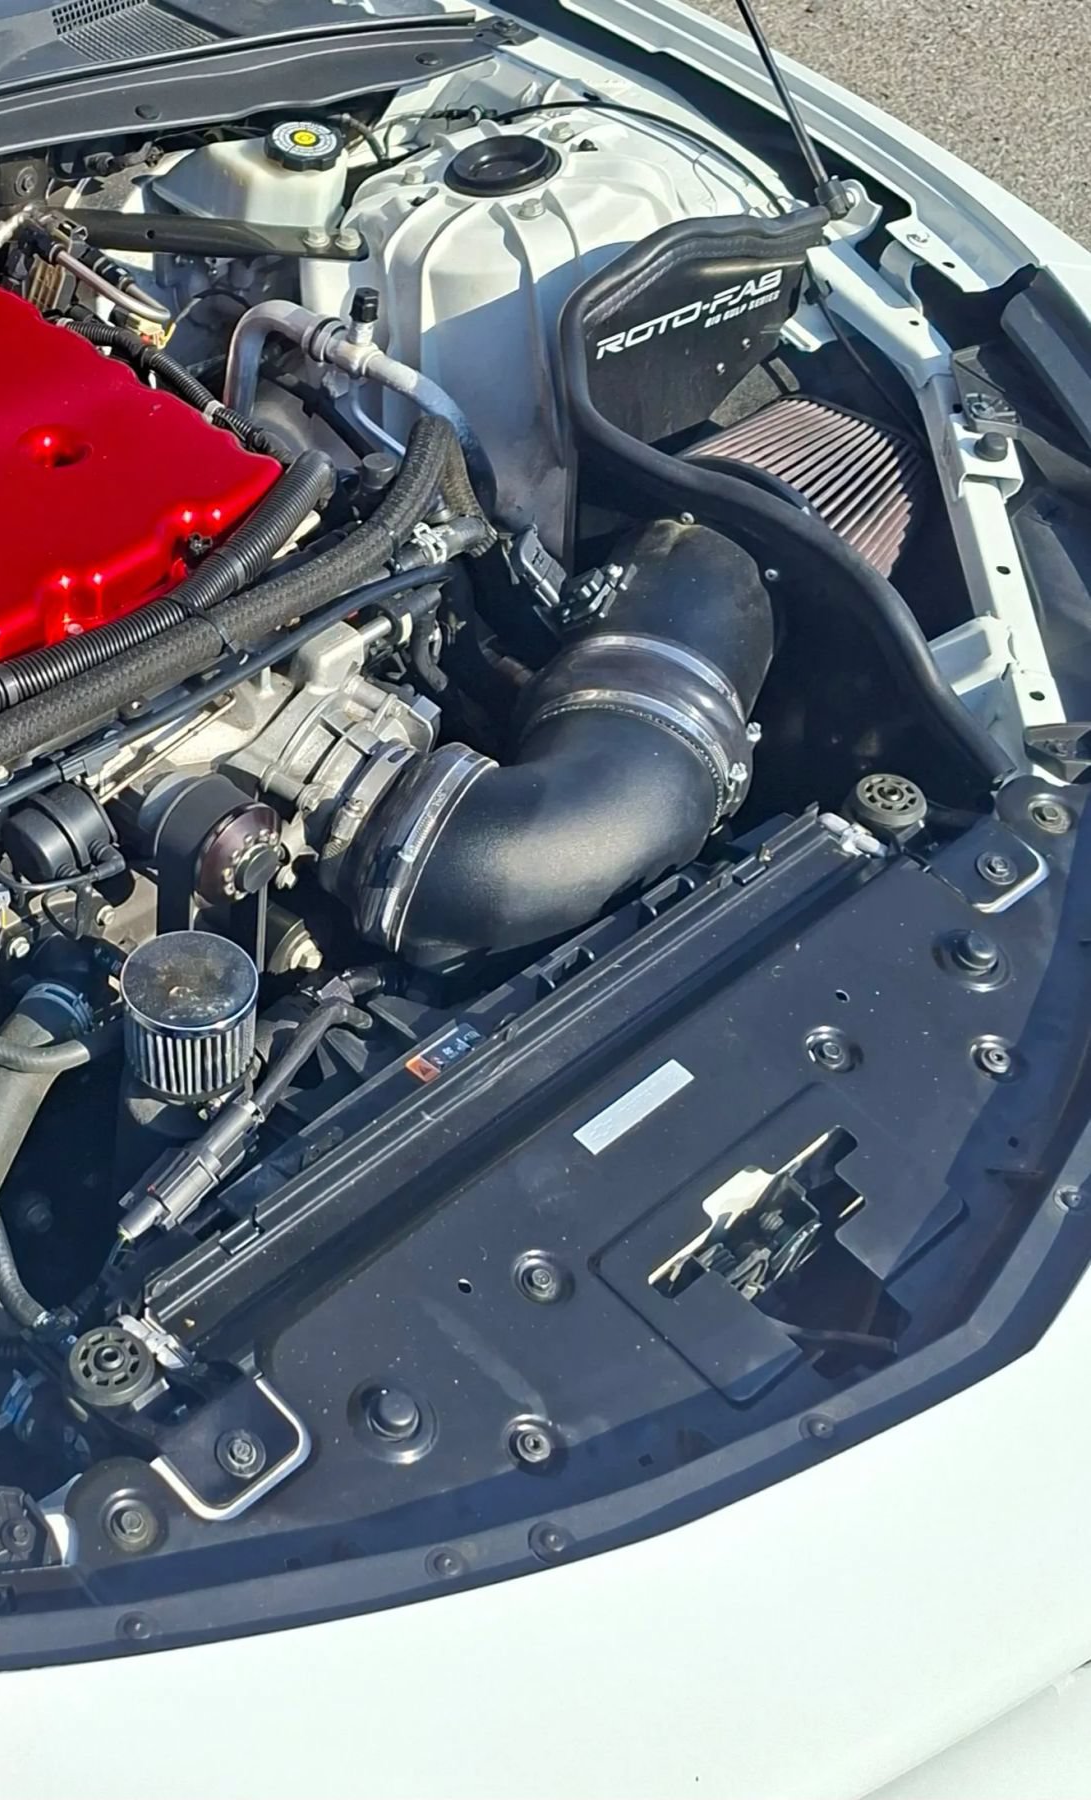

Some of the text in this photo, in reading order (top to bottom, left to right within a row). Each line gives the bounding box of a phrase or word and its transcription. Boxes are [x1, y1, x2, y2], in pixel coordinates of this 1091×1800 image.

[596, 269, 783, 360] ROTO-FAB
[723, 303, 747, 321] GULP
[748, 290, 781, 311] SERIES
